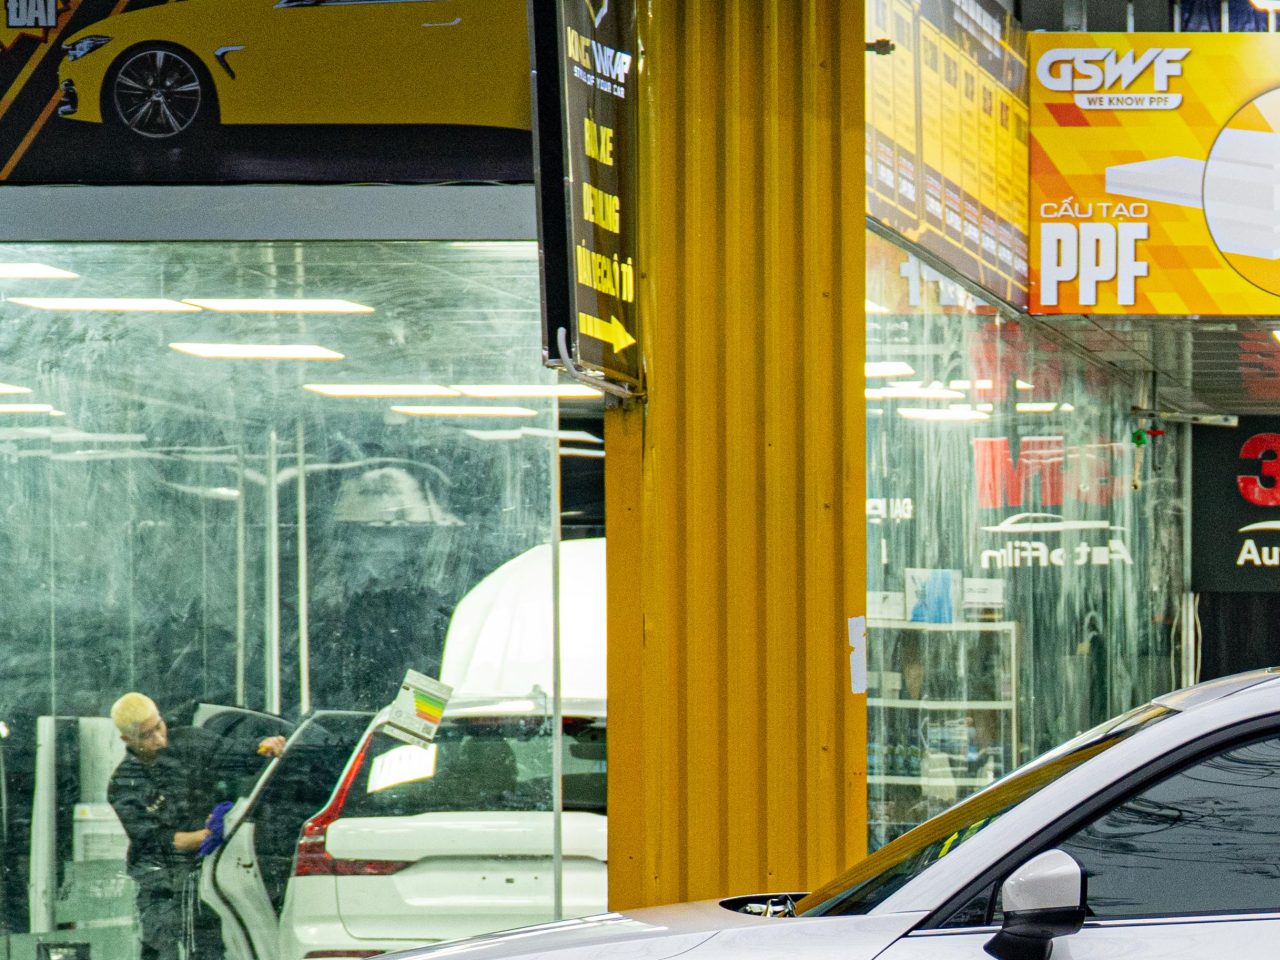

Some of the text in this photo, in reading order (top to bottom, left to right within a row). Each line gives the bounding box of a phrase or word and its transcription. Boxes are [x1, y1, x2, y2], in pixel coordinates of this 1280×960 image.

[591, 39, 633, 84] WRAP
[1035, 47, 1192, 93] GSWF
[612, 83, 626, 100] CAR
[1087, 96, 1170, 107] WE KNOW PPF
[1039, 196, 1149, 222] CẤU TẠO
[1039, 223, 1149, 306] PPF
